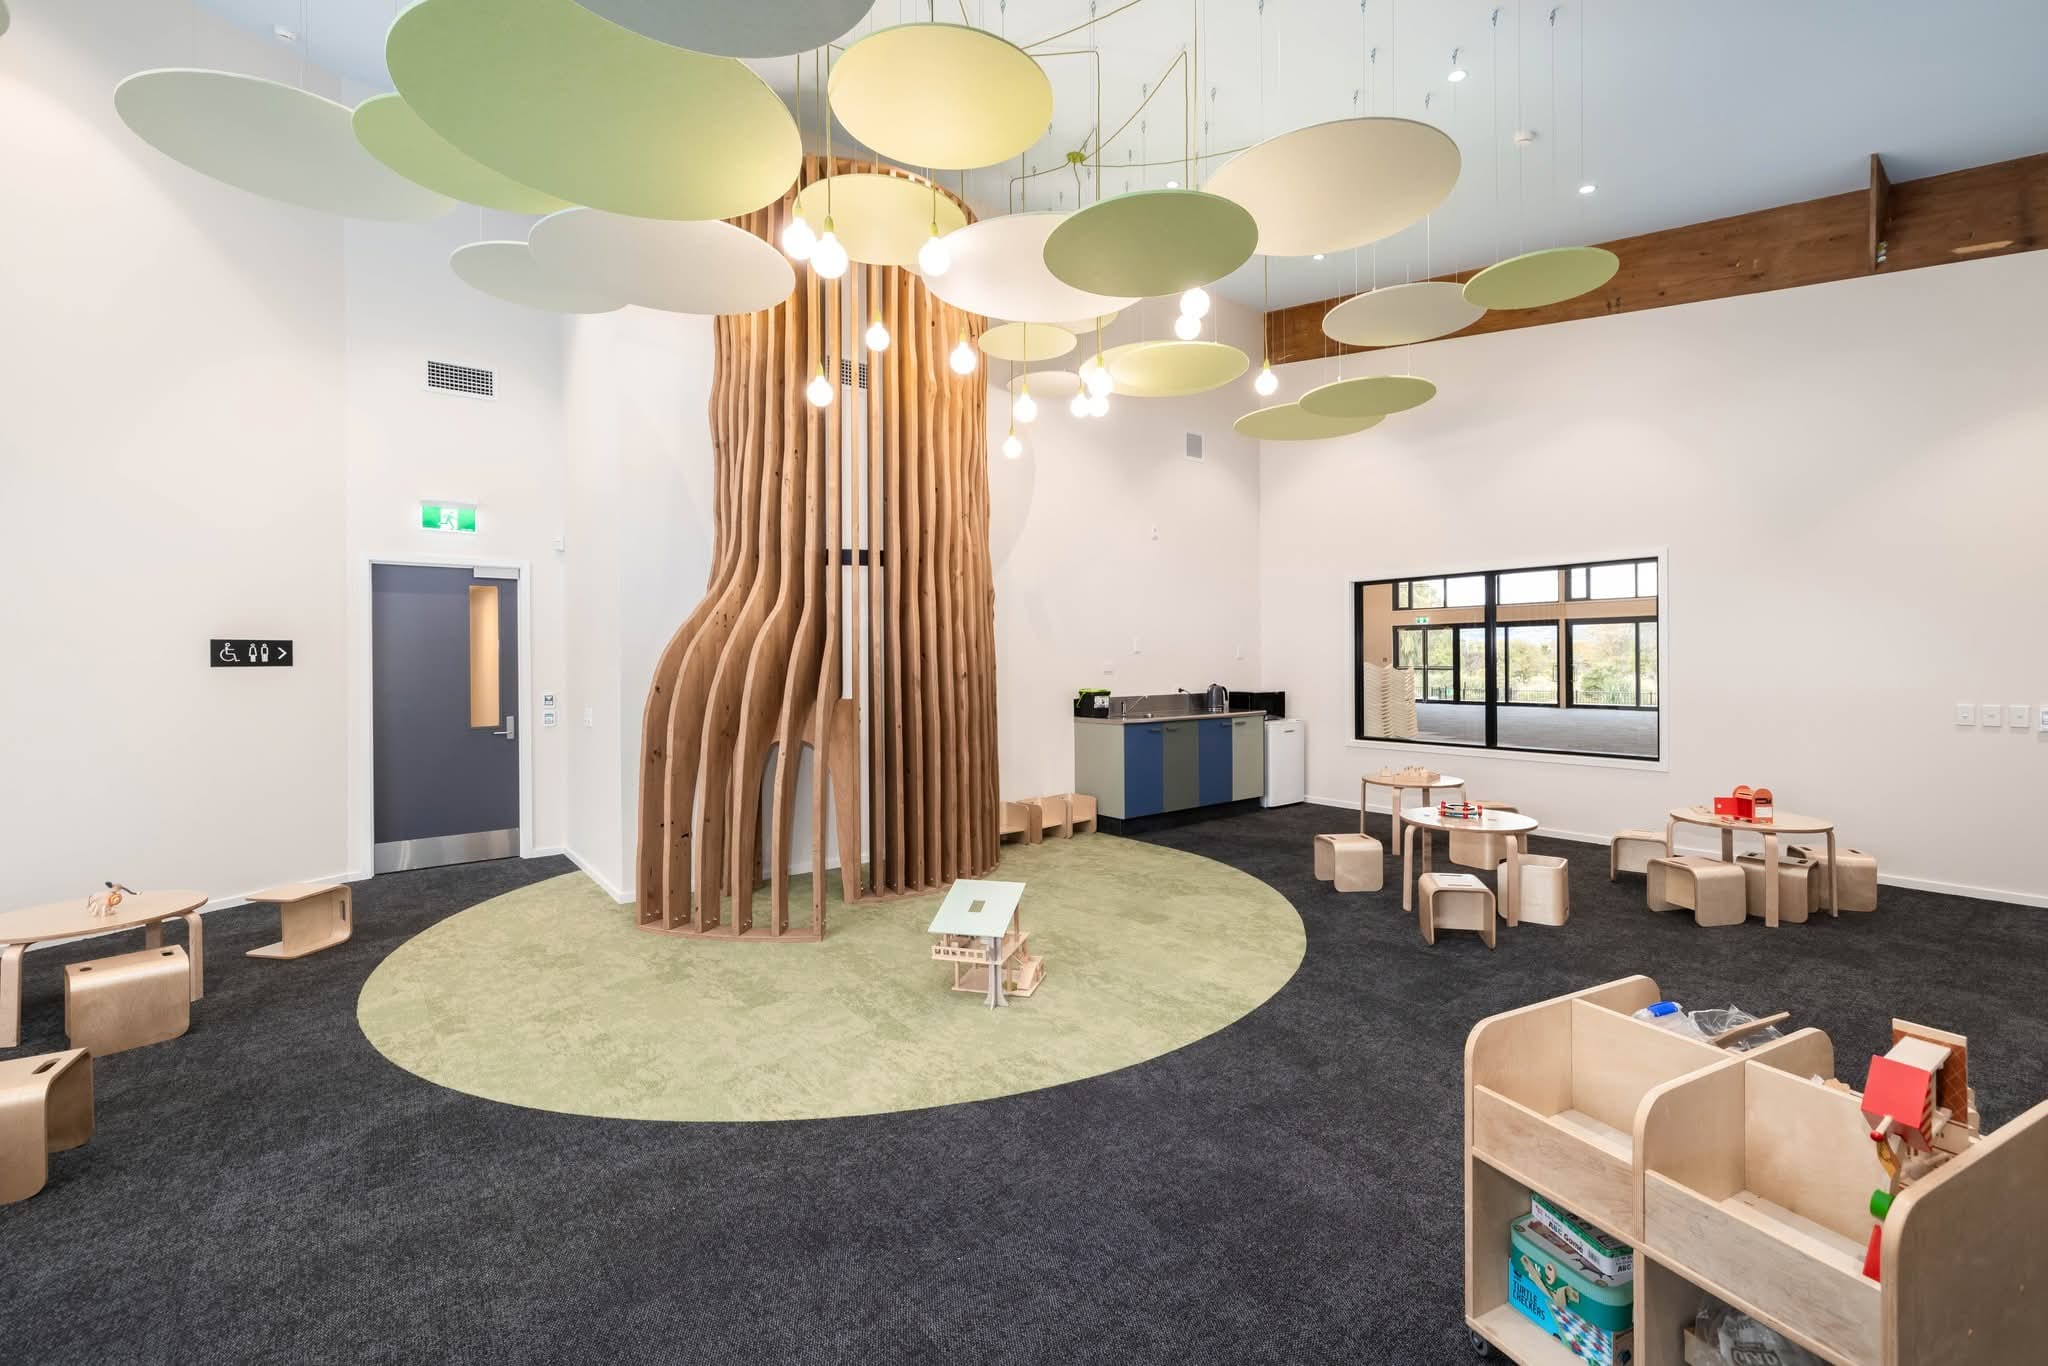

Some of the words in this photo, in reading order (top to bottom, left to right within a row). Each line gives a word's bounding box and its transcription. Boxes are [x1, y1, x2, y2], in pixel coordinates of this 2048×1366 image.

[1548, 1221, 1563, 1236] ABC
[1563, 1233, 1583, 1253] Game
[1617, 1264, 1632, 1273] ABC
[1513, 1280, 1537, 1305] TURTLE
[1513, 1289, 1545, 1320] CHECKERS
